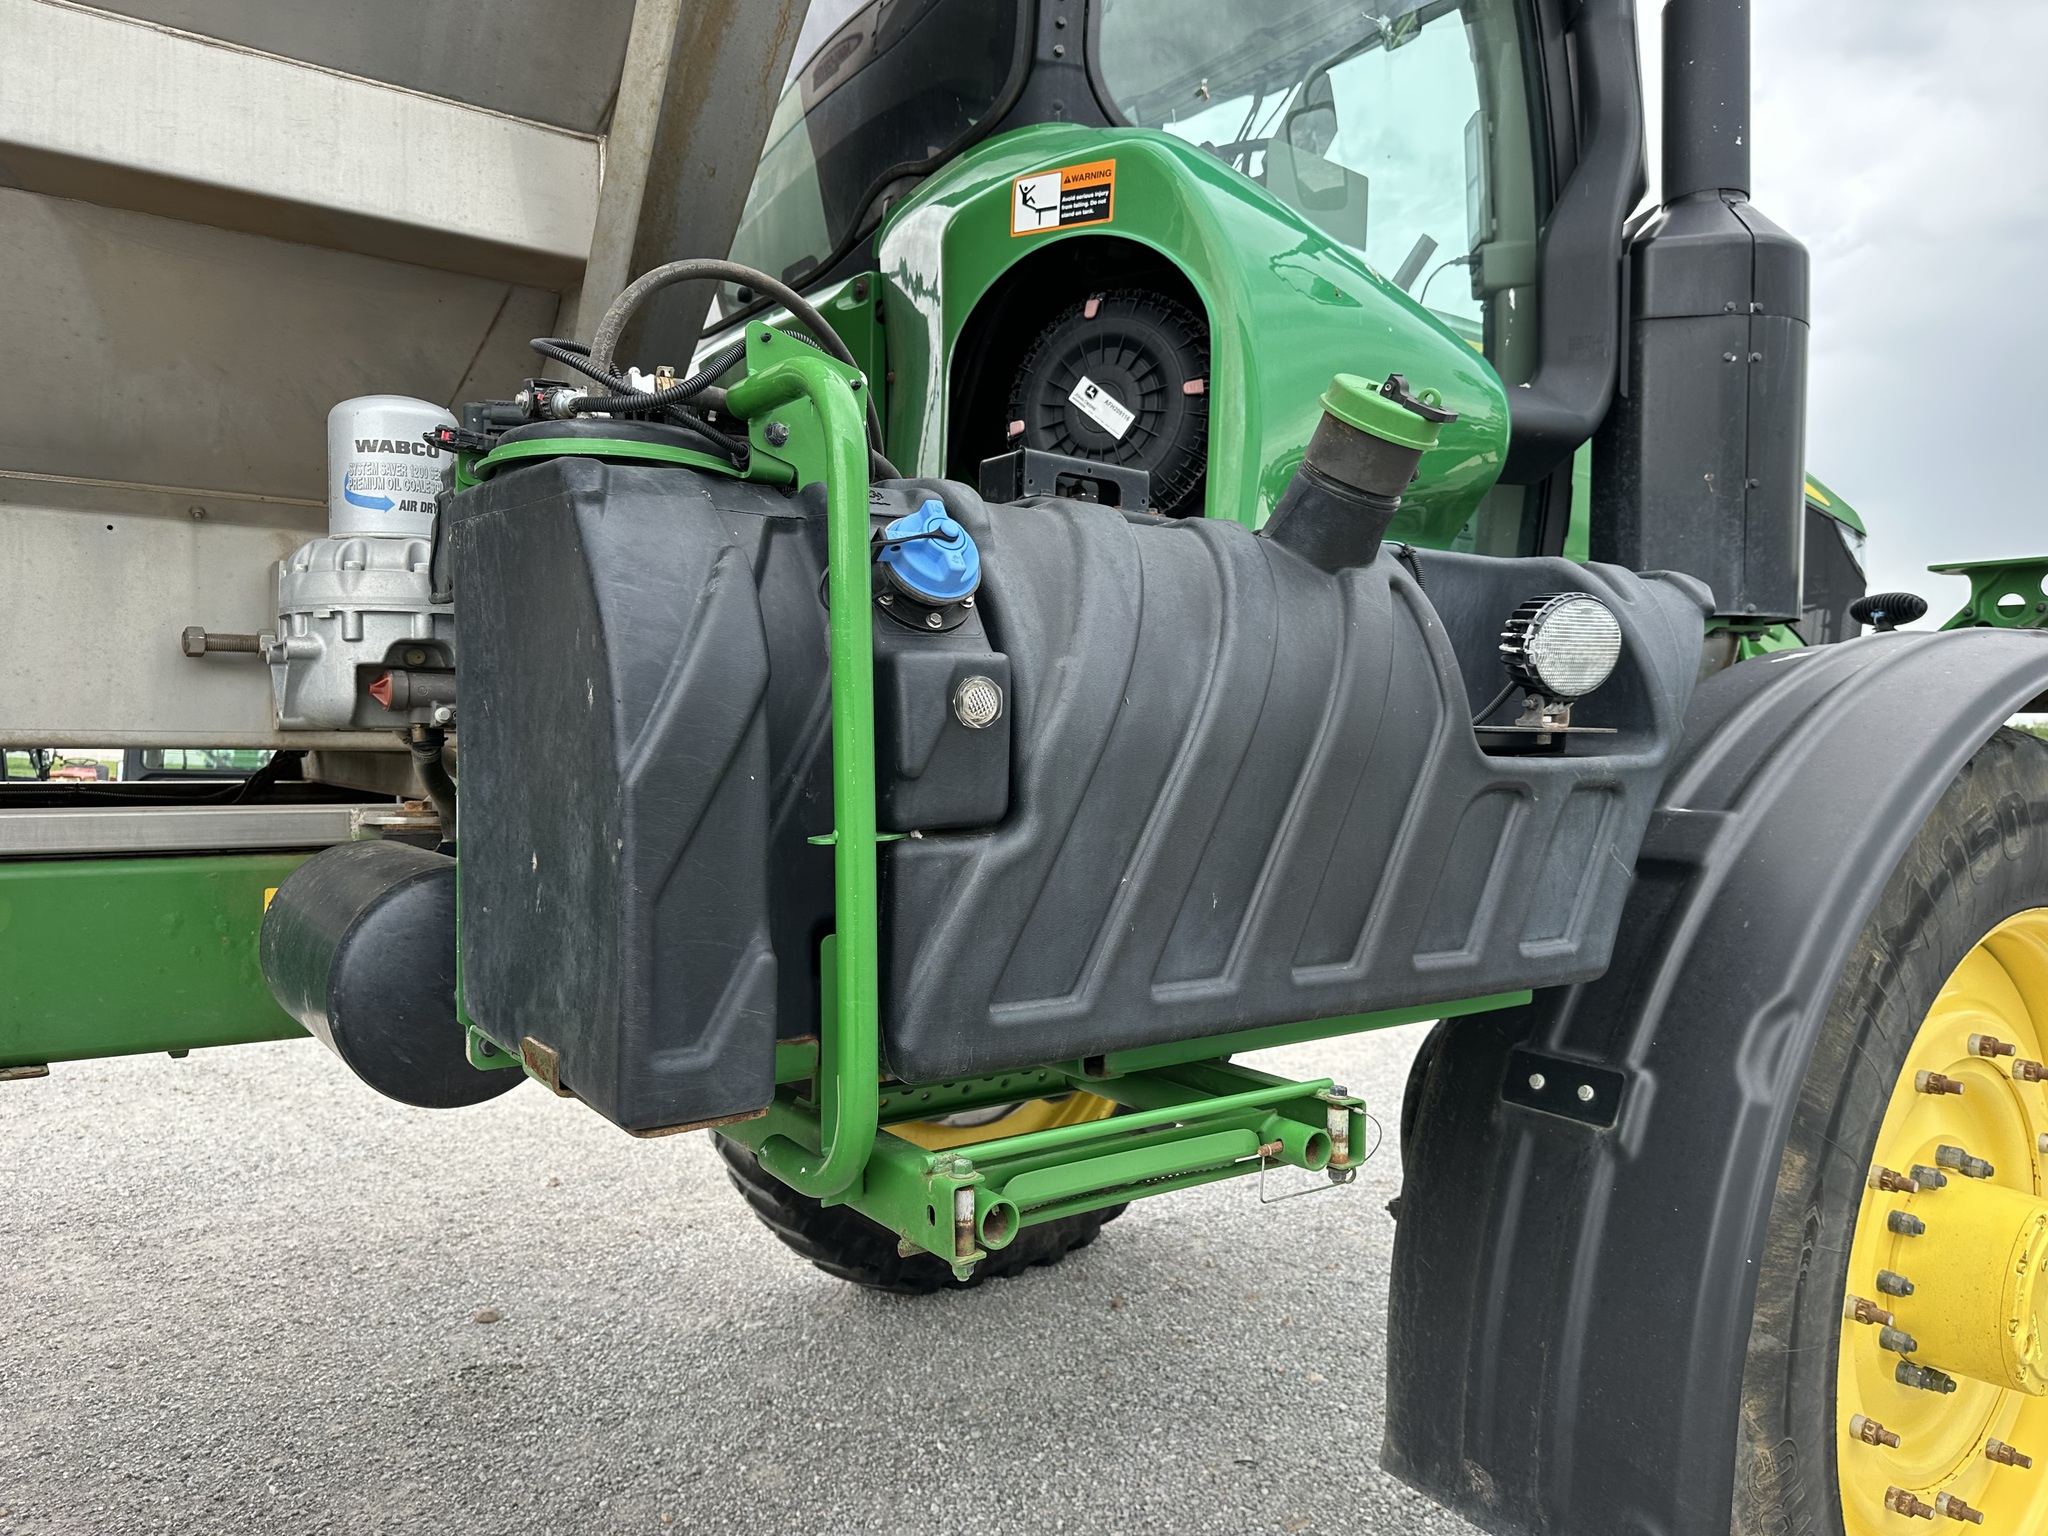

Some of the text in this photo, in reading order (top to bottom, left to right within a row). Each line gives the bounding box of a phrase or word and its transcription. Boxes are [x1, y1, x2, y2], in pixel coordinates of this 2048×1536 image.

[1071, 169, 1111, 182] WARNING
[355, 440, 440, 458] WABCO
[349, 463, 379, 476] SYSTEM
[380, 463, 407, 477] SAVER
[410, 466, 429, 480] 1200
[348, 477, 386, 491] PREMIUM
[387, 478, 402, 492] OIL
[398, 499, 418, 512] AIR
